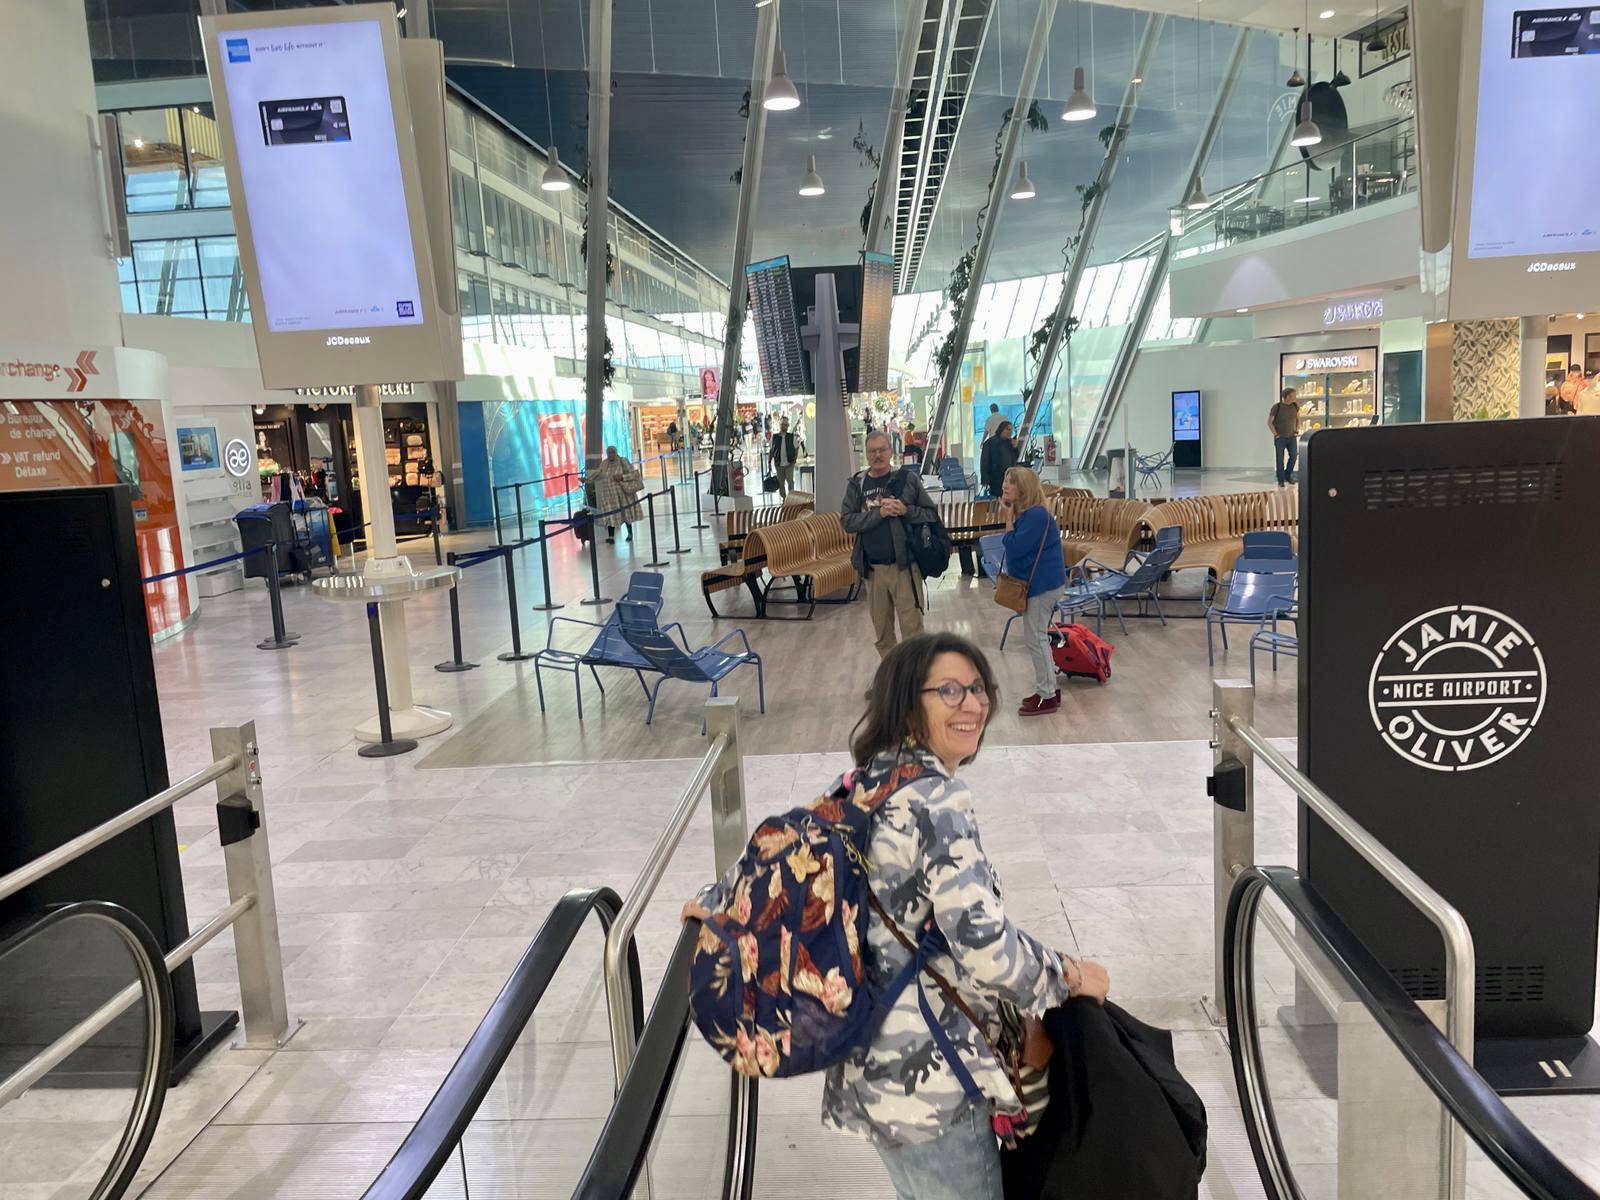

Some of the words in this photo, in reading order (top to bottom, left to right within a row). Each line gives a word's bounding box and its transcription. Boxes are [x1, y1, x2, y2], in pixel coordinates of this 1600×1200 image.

[1527, 262, 1576, 273] JCDecaux
[326, 336, 370, 346] JCDecaux
[1306, 356, 1358, 369] SWAROVSKI
[379, 382, 415, 396] ECRET
[8, 414, 44, 424] Bureaux
[10, 428, 22, 439] de
[26, 426, 57, 439] change
[13, 452, 29, 463] VAT
[33, 449, 60, 461] refund
[15, 466, 47, 478] Détaxe
[1397, 614, 1523, 663] JAMIE
[1393, 682, 1434, 699] NICE
[1443, 680, 1522, 697] AIRPORT
[1388, 712, 1529, 763] OLIVER
